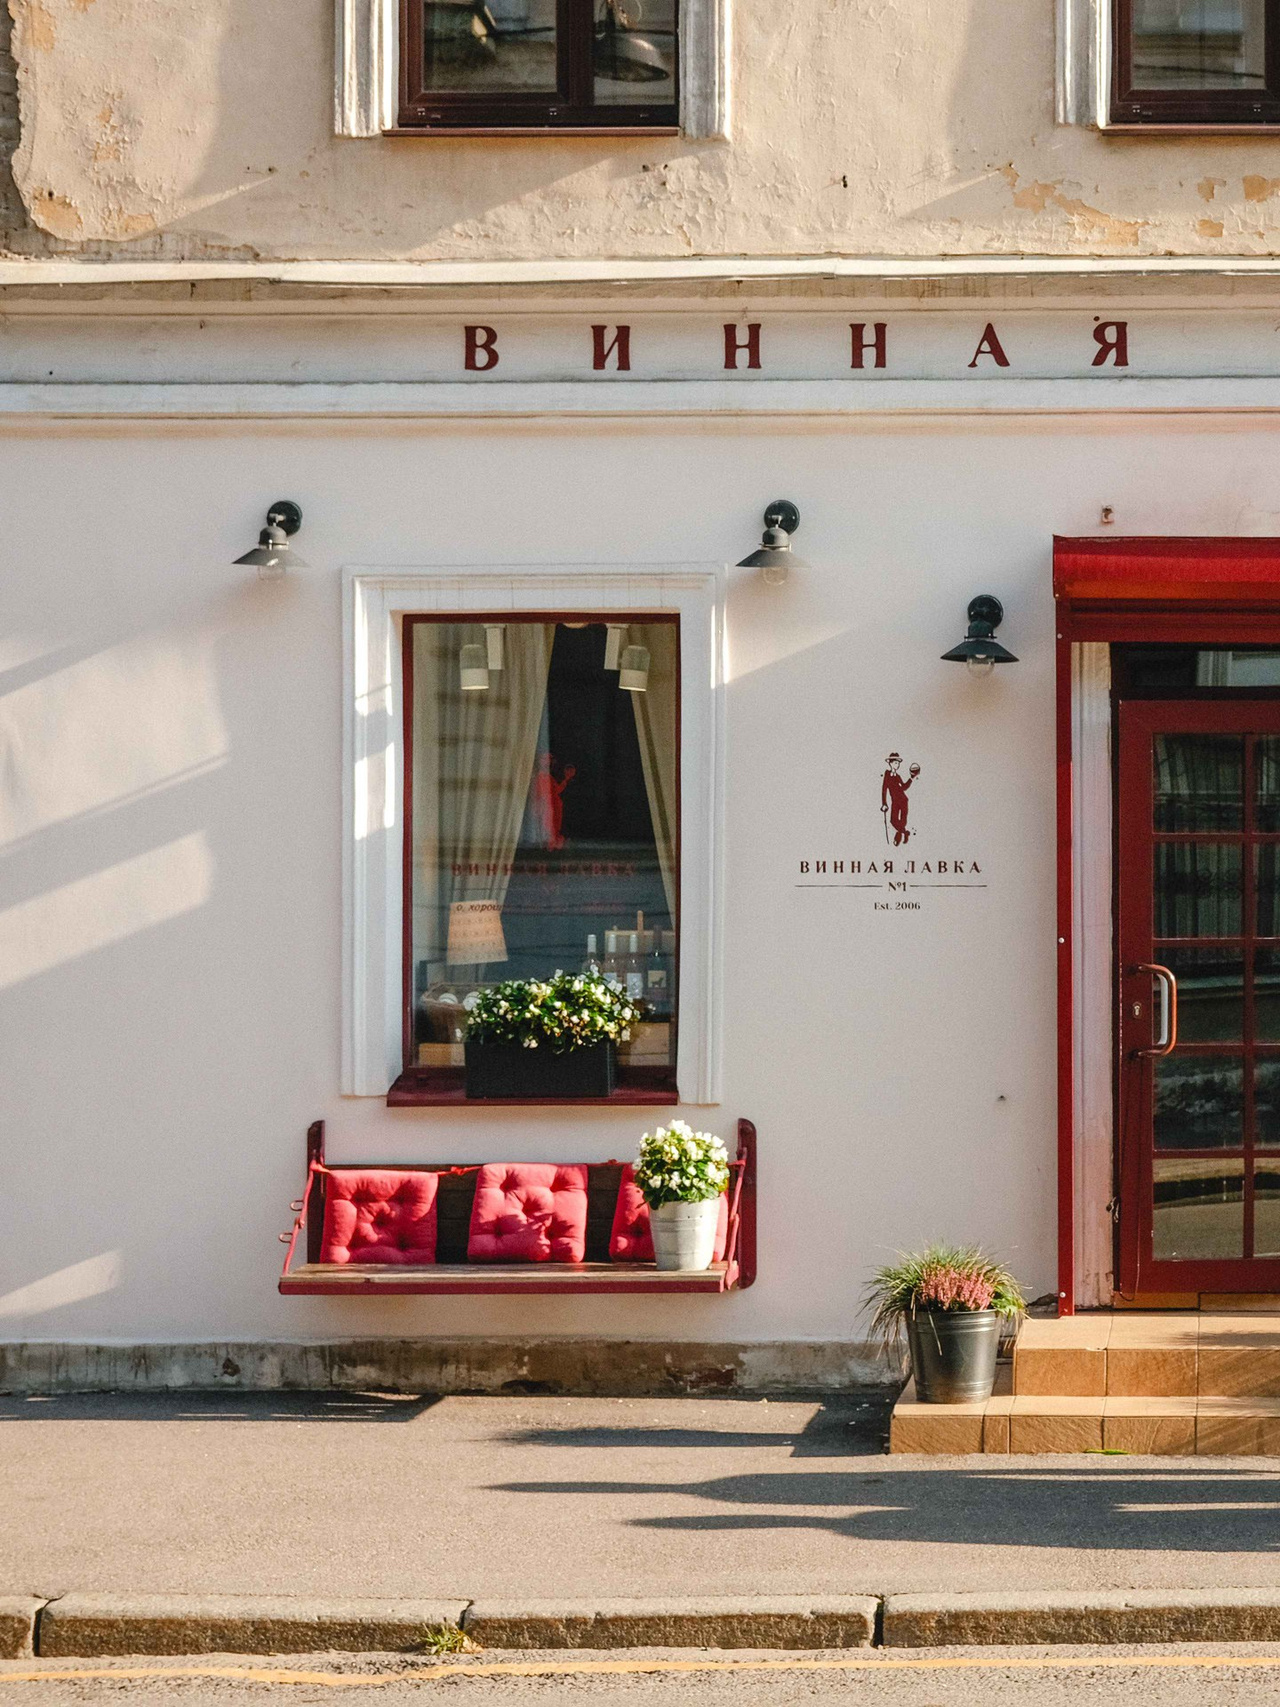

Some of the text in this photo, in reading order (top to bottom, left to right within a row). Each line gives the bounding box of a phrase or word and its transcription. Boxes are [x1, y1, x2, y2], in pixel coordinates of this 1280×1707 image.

[463, 316, 1129, 371] ВИННАЯ
[799, 860, 981, 874] ВИННАЯ ЛАВКА
[874, 902, 921, 910] Est. 2006
